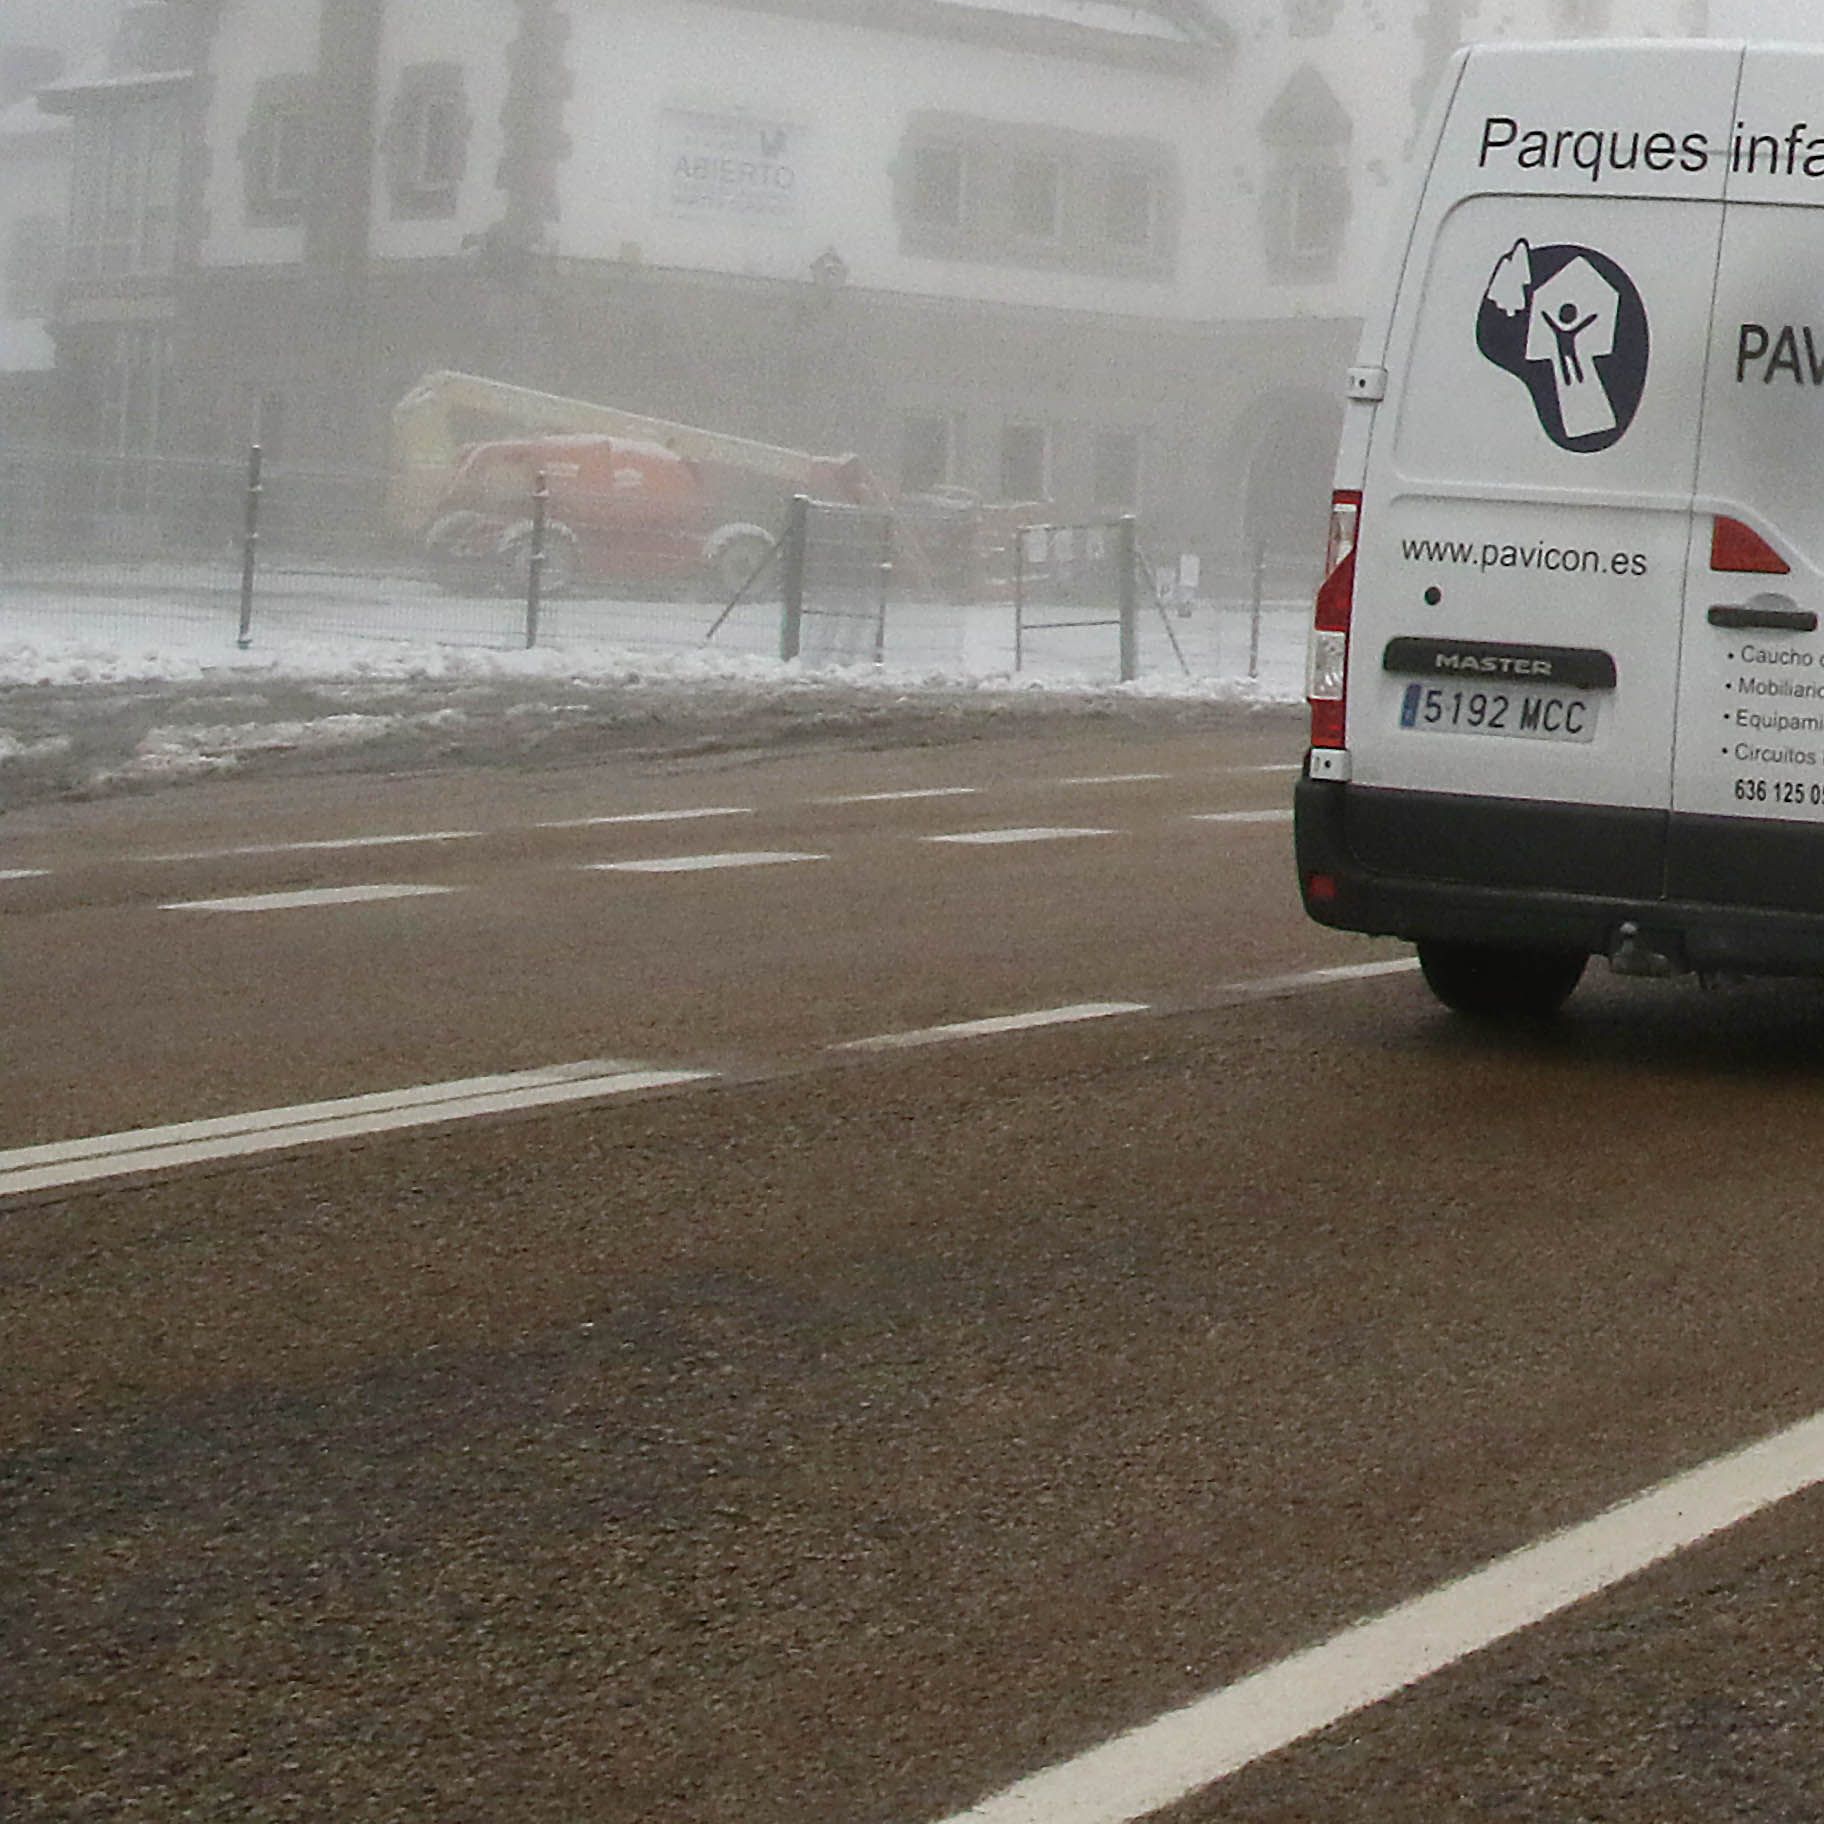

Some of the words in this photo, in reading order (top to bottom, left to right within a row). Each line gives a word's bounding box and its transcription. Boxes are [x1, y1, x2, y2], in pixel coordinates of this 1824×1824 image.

[1478, 117, 1709, 182] Parques
[1400, 536, 1648, 577] www.pavicon.es
[1435, 653, 1552, 675] MASTER
[1741, 645, 1813, 666] Caucho
[1424, 690, 1510, 728] 5192
[1520, 697, 1587, 734] MCC
[1735, 742, 1816, 764] Circuitos
[1734, 779, 1767, 801] 636
[1775, 782, 1804, 803] 125
